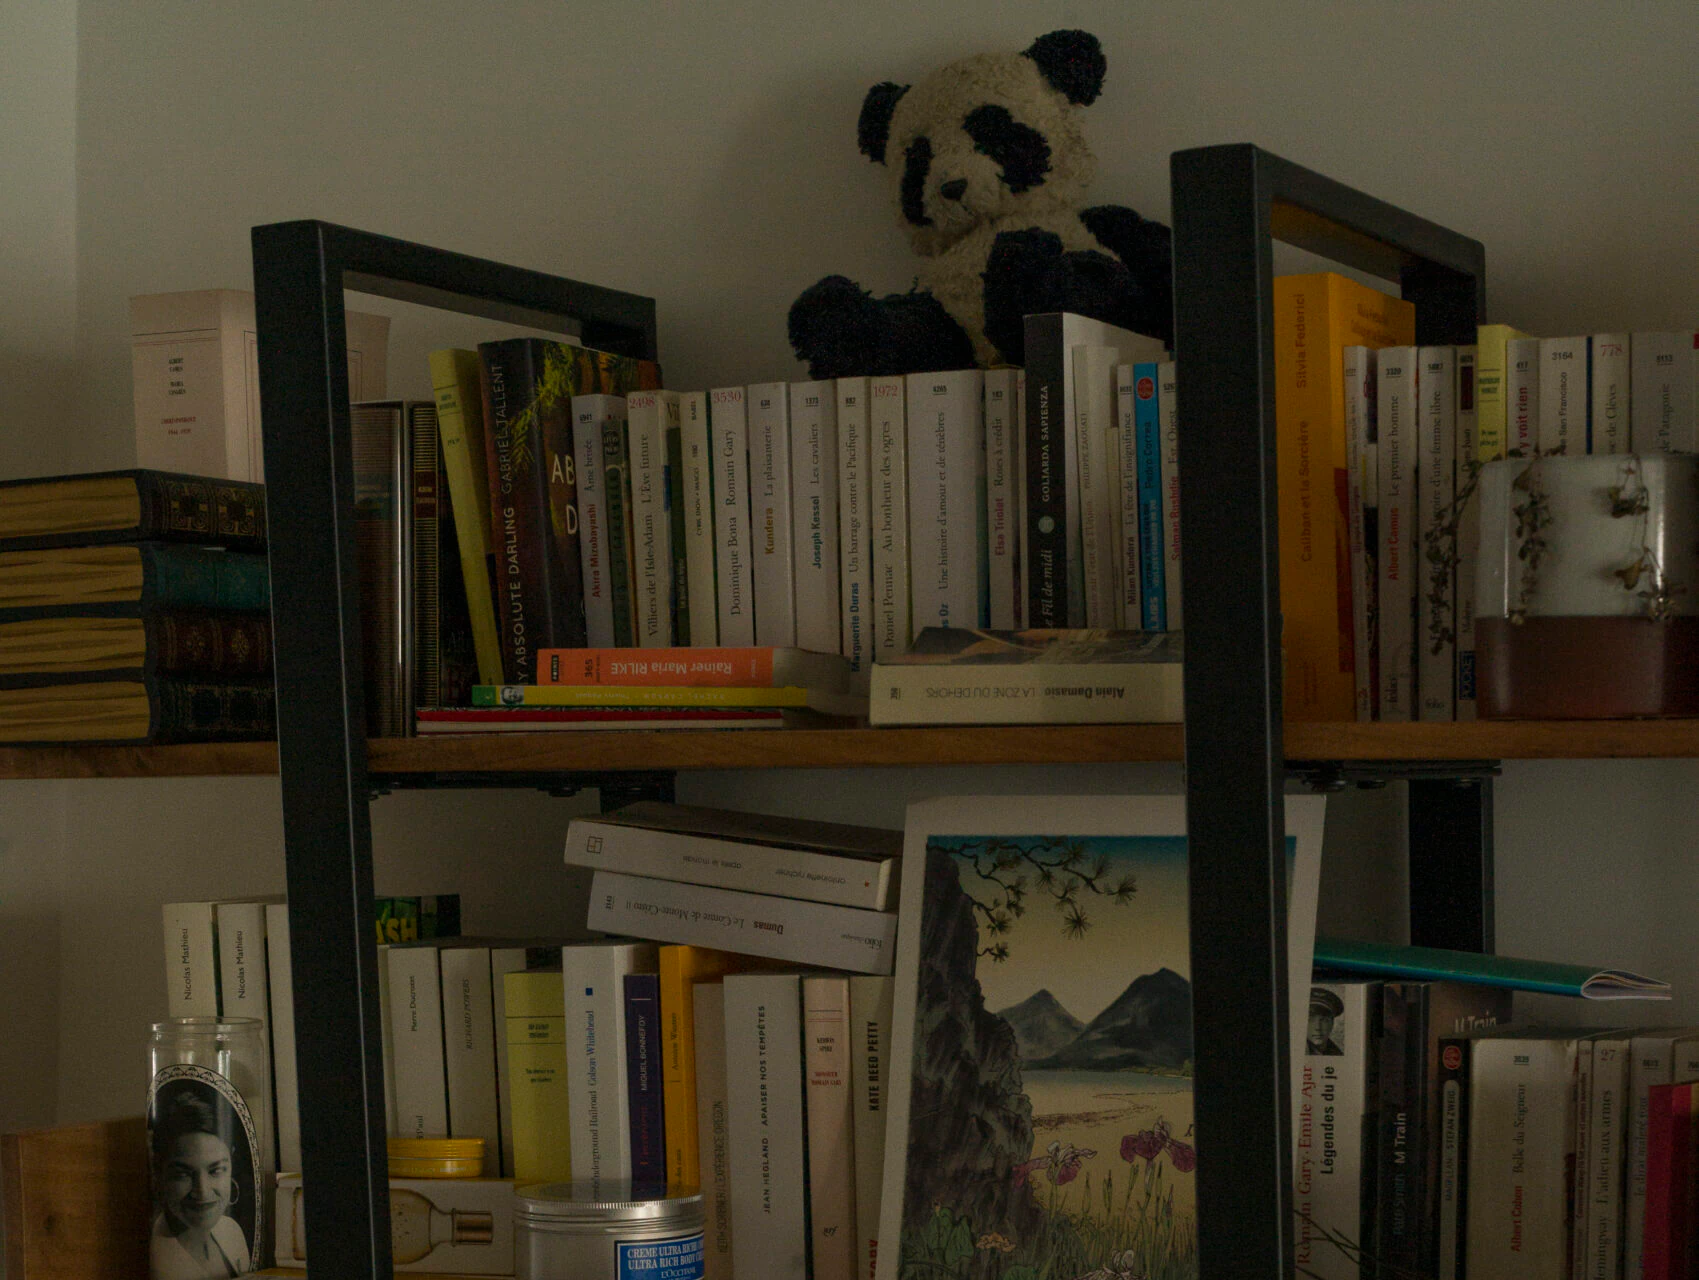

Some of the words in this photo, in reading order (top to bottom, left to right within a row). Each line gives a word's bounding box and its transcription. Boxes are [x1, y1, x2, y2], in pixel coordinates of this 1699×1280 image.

[1294, 294, 1307, 347] Federici
[1295, 351, 1308, 388] Silvia
[492, 365, 509, 426] TALLENT
[1040, 385, 1049, 440] SAPIENZA
[1389, 395, 1400, 436] homme
[723, 428, 736, 458] Gary
[880, 421, 891, 455] ogres
[498, 426, 514, 494] GABRIEL
[880, 459, 891, 476] des
[1389, 439, 1402, 476] premier
[724, 460, 737, 506] Romain
[1041, 445, 1050, 502] GOLIARDA
[1299, 480, 1311, 492] la
[1389, 481, 1400, 496] Le
[880, 480, 891, 532] bonheur
[1301, 496, 1311, 508] et
[504, 507, 520, 574] DARLING
[726, 517, 738, 547] Bona
[1299, 512, 1313, 562] Caliban
[1389, 508, 1400, 545] Camus
[881, 536, 892, 551] Au
[1041, 549, 1052, 576] midi
[1389, 549, 1400, 580] Albert
[728, 550, 741, 615] Dominique
[883, 564, 894, 606] Pennac
[1042, 580, 1053, 595] de
[1042, 599, 1053, 615] Fil
[510, 582, 527, 667] ABSOLUTE
[883, 610, 894, 648] Daniel
[611, 662, 647, 675] RILKE
[651, 662, 687, 675] Maria
[690, 662, 732, 675] Rainer
[926, 688, 970, 697] DEHORS
[973, 688, 990, 697] DU
[1044, 687, 1092, 698] Damasio
[1096, 687, 1124, 698] Alain
[691, 911, 700, 922] de
[703, 912, 731, 927] Comte
[733, 918, 744, 929] Le
[753, 920, 783, 935] Dumas
[180, 928, 190, 964] Mathieu
[235, 931, 245, 965] Mathieu
[182, 967, 192, 1000] Nicolas
[236, 968, 246, 998] Nicolas
[757, 1005, 767, 1056] TEMPÊTES
[867, 1021, 878, 1053] PETTY
[759, 1060, 767, 1080] NOS
[868, 1056, 879, 1081] REED
[1322, 1066, 1338, 1079] je
[759, 1084, 768, 1125] APAISER
[868, 1085, 880, 1111] KATE
[1322, 1084, 1335, 1101] du
[1513, 1083, 1526, 1128] Seigneur
[1322, 1106, 1335, 1174] Légendes
[1393, 1113, 1407, 1148] Train
[1514, 1131, 1524, 1145] du
[761, 1138, 770, 1185] HEGLAND
[1396, 1152, 1407, 1163] M
[1513, 1147, 1524, 1173] Belle
[762, 1189, 771, 1214] JEAN
[1511, 1219, 1522, 1252] Albert
